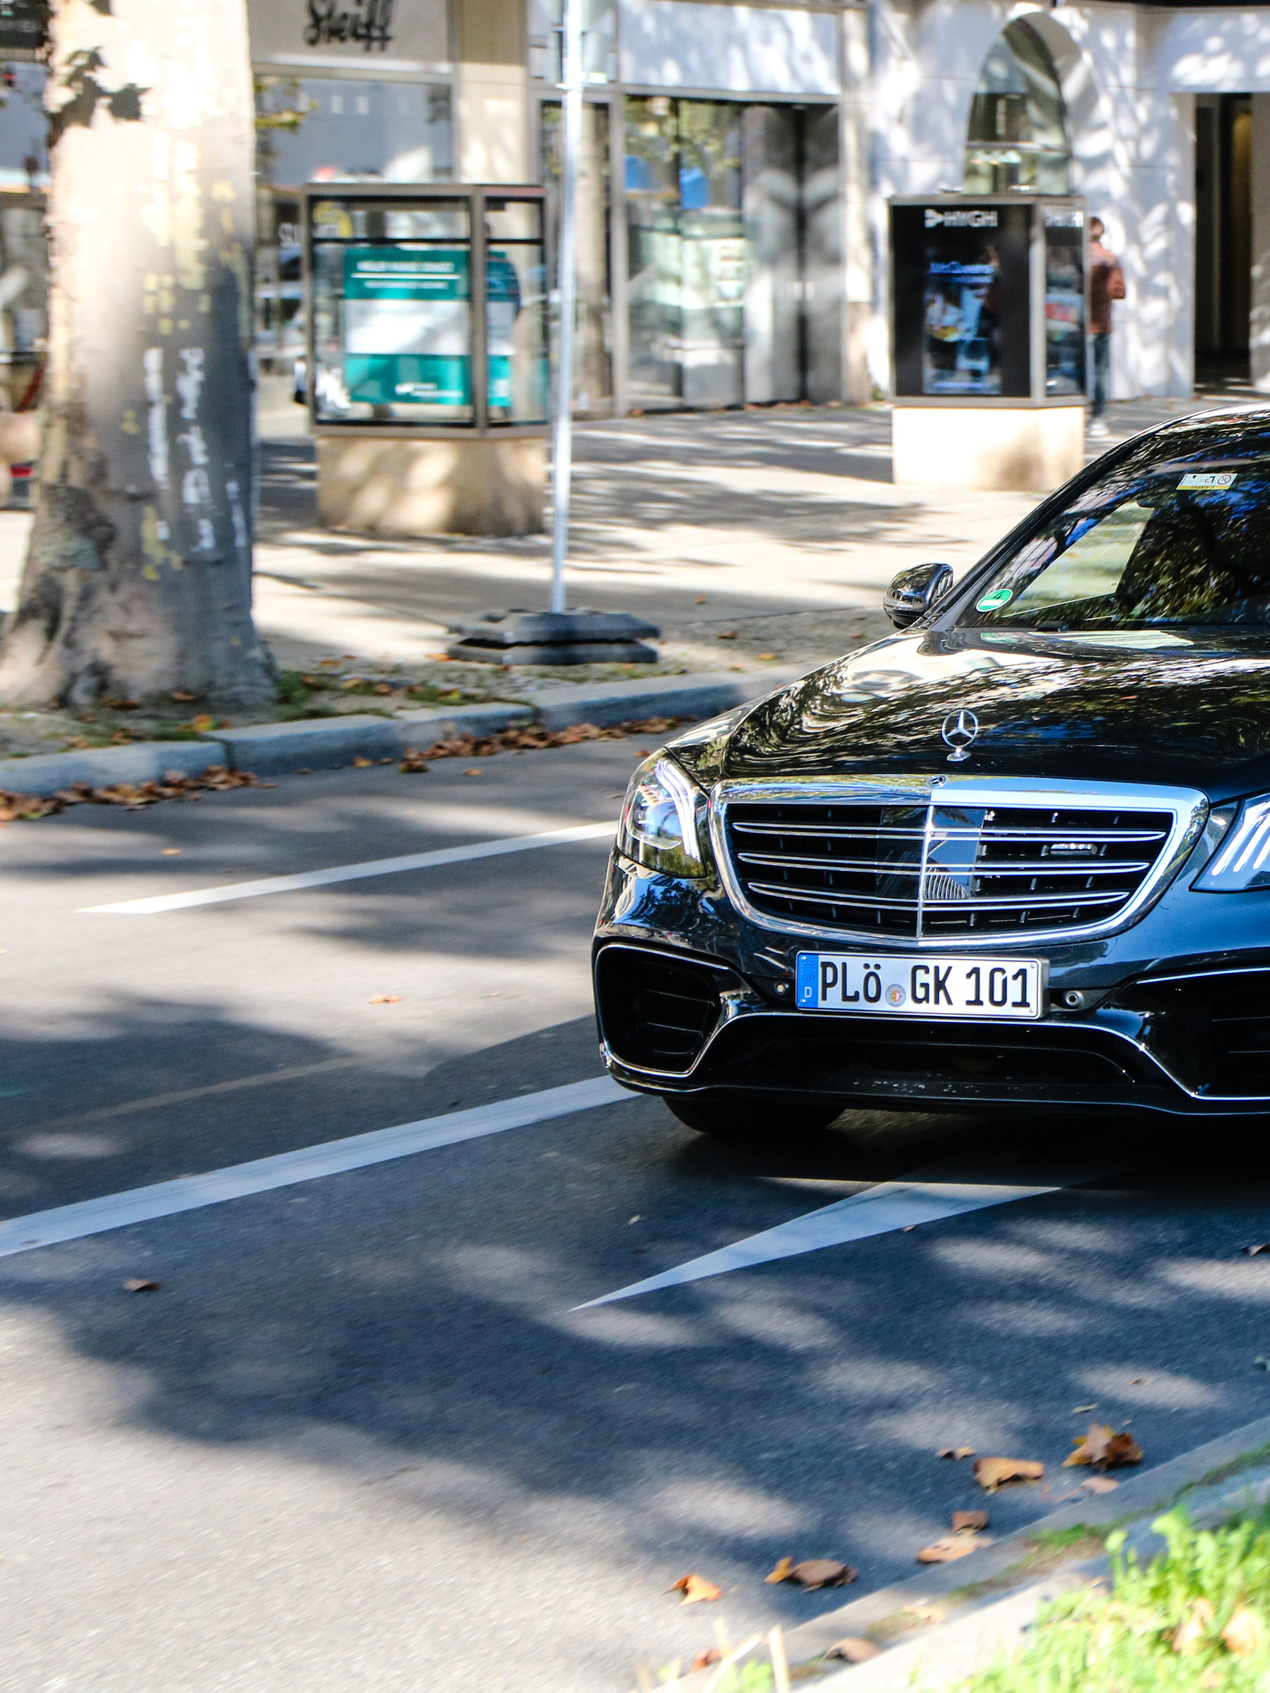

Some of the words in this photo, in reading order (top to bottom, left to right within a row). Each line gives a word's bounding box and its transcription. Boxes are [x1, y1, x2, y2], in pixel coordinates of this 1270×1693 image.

[804, 987, 812, 998] D
[820, 961, 882, 1004] PLÖ
[911, 965, 953, 1006] GK
[965, 966, 1031, 1008] 101
